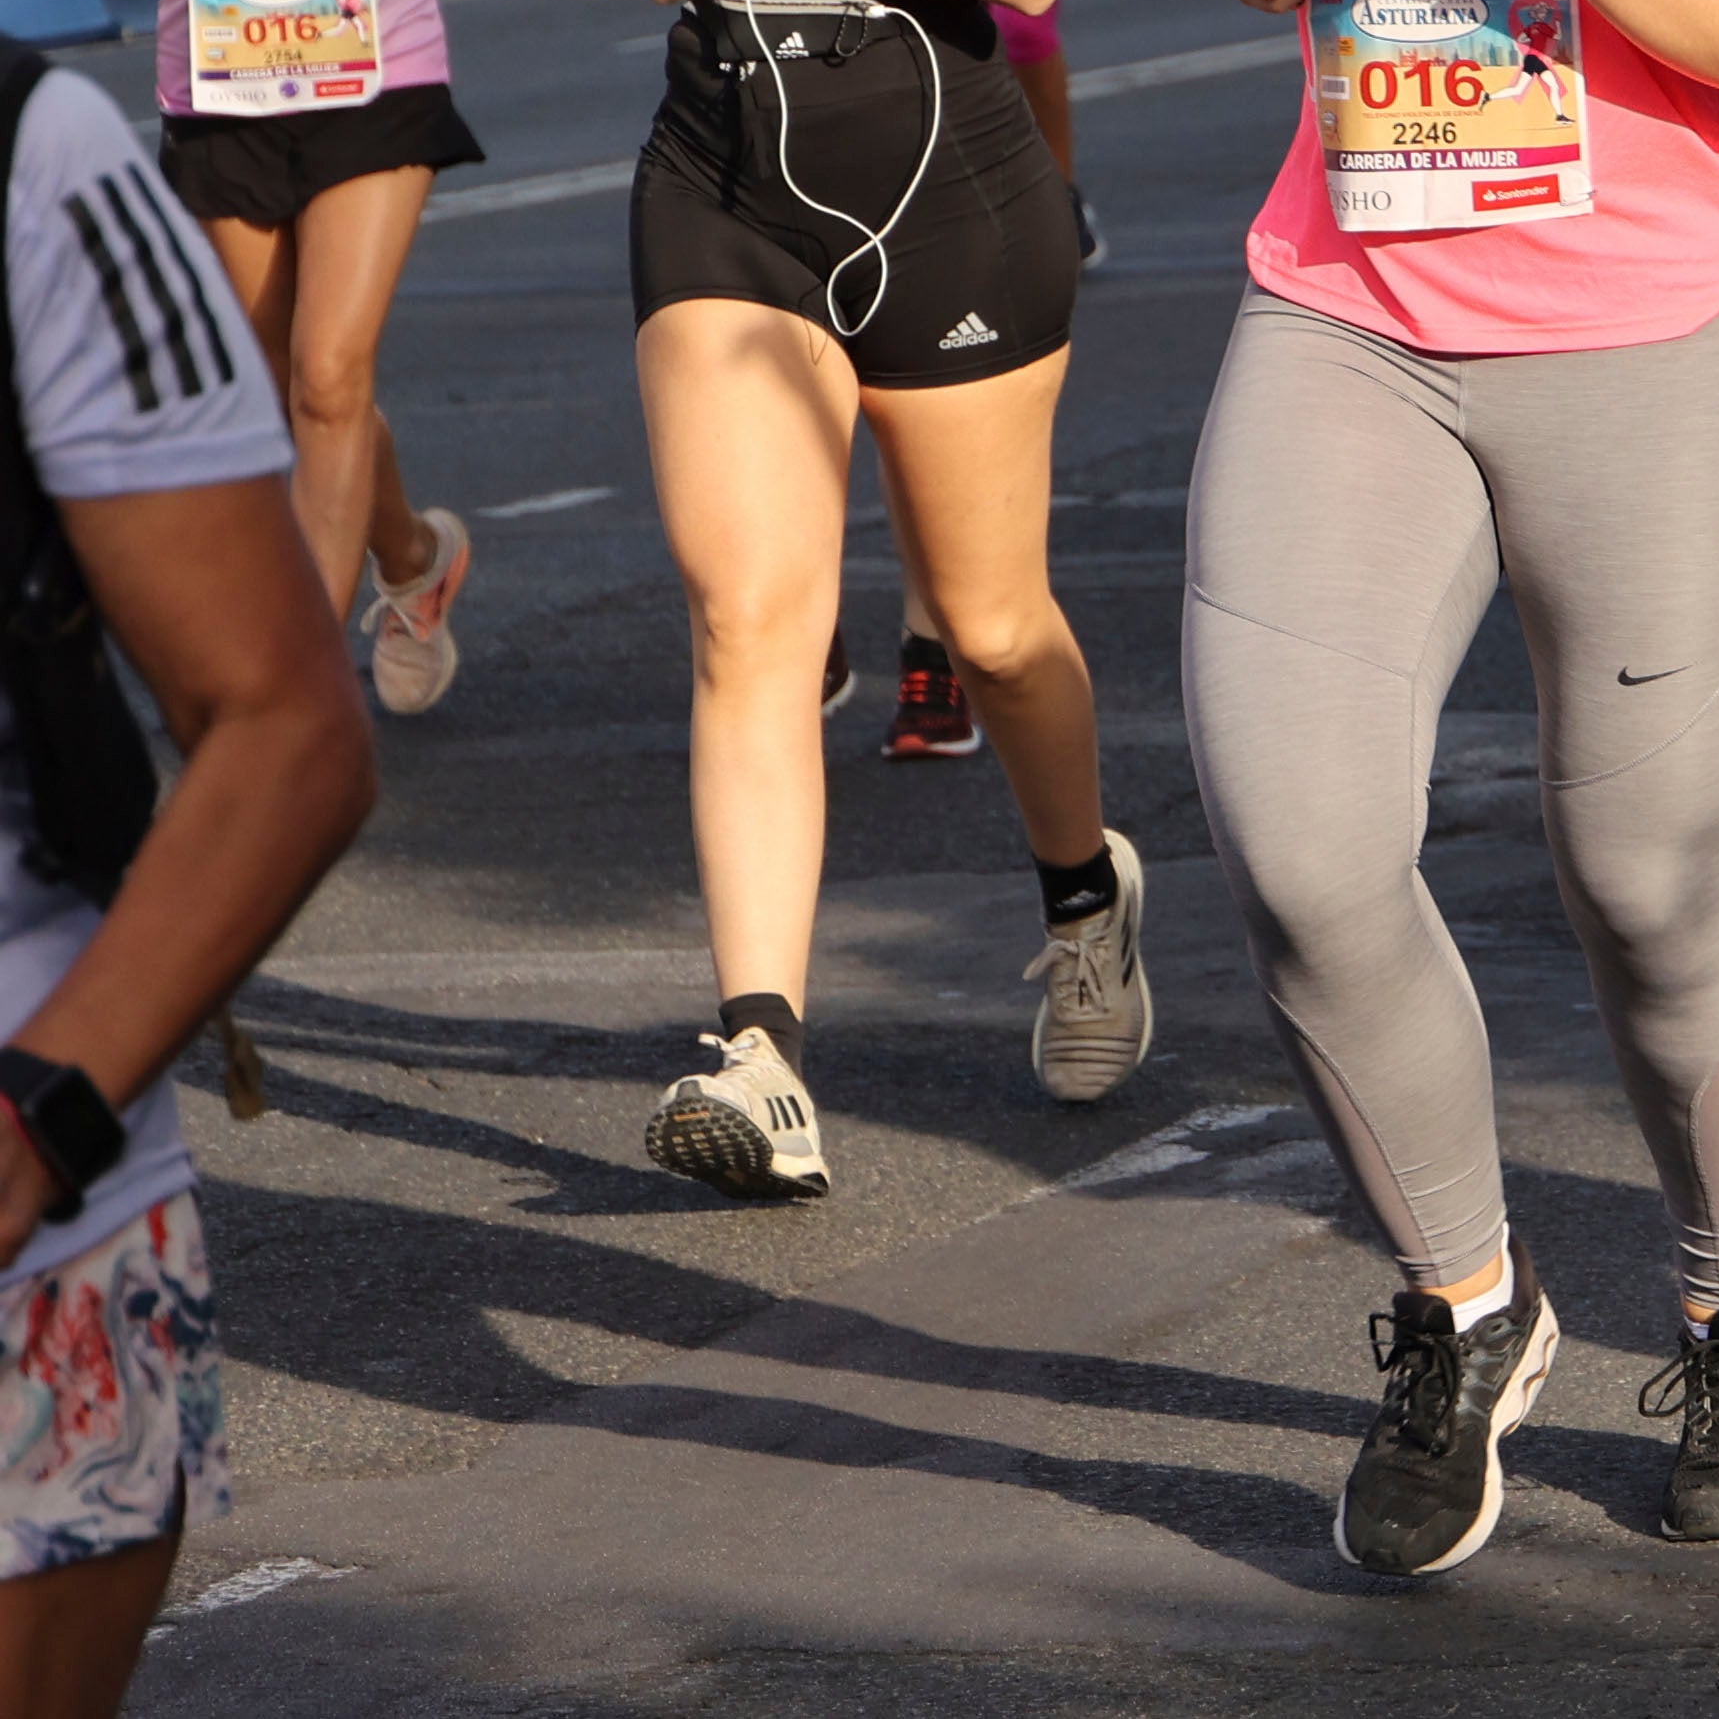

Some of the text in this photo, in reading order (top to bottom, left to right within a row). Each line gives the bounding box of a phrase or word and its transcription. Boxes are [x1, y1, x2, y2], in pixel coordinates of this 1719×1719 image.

[244, 12, 321, 46] 016
[1359, 59, 1485, 110] 016
[1392, 121, 1457, 145] 2246
[1338, 150, 1519, 170] CARRERA DE LA MUJER
[1496, 184, 1550, 202] Santander
[938, 328, 999, 351] adidas
